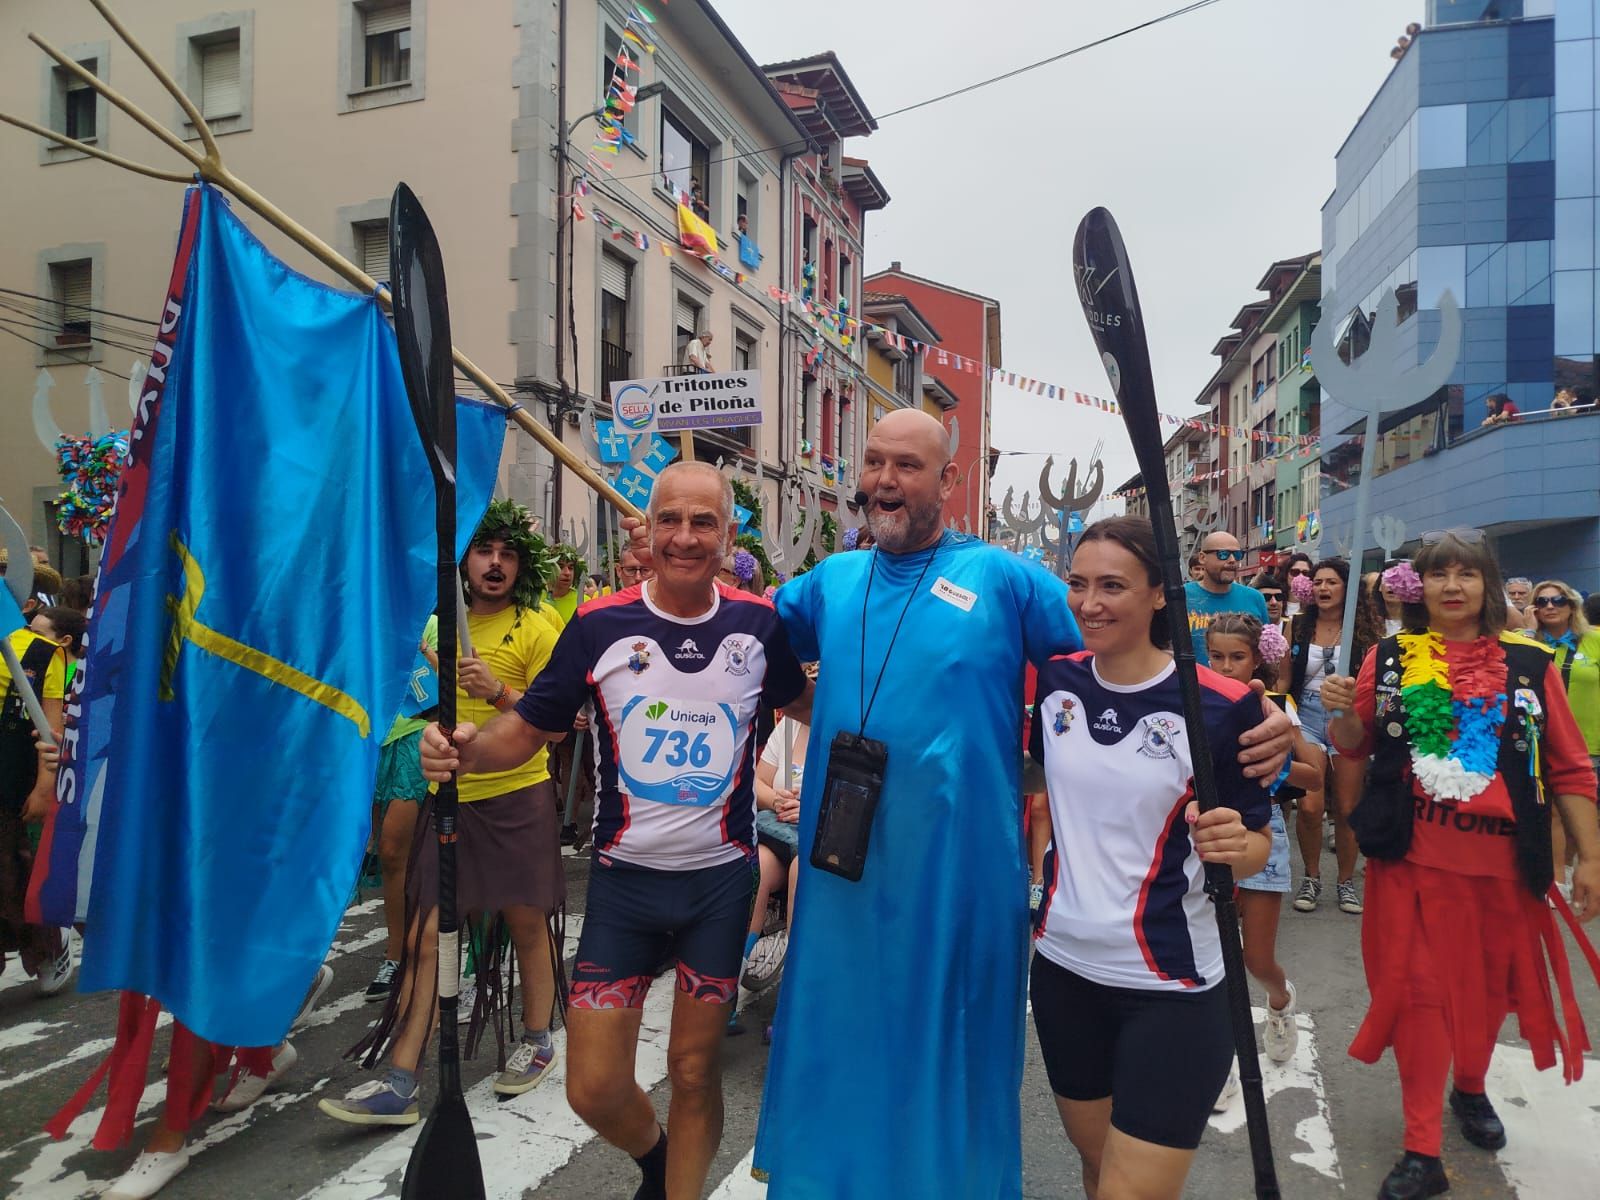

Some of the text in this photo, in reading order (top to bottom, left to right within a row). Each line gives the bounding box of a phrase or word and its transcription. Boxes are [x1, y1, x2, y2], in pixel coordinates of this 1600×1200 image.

[661, 376, 748, 394] Tritones
[622, 405, 650, 416] SELLA
[659, 396, 757, 414] de Piloña
[670, 709, 717, 727] Unicaja
[641, 727, 712, 768] 736
[1413, 796, 1517, 835] RITONE
